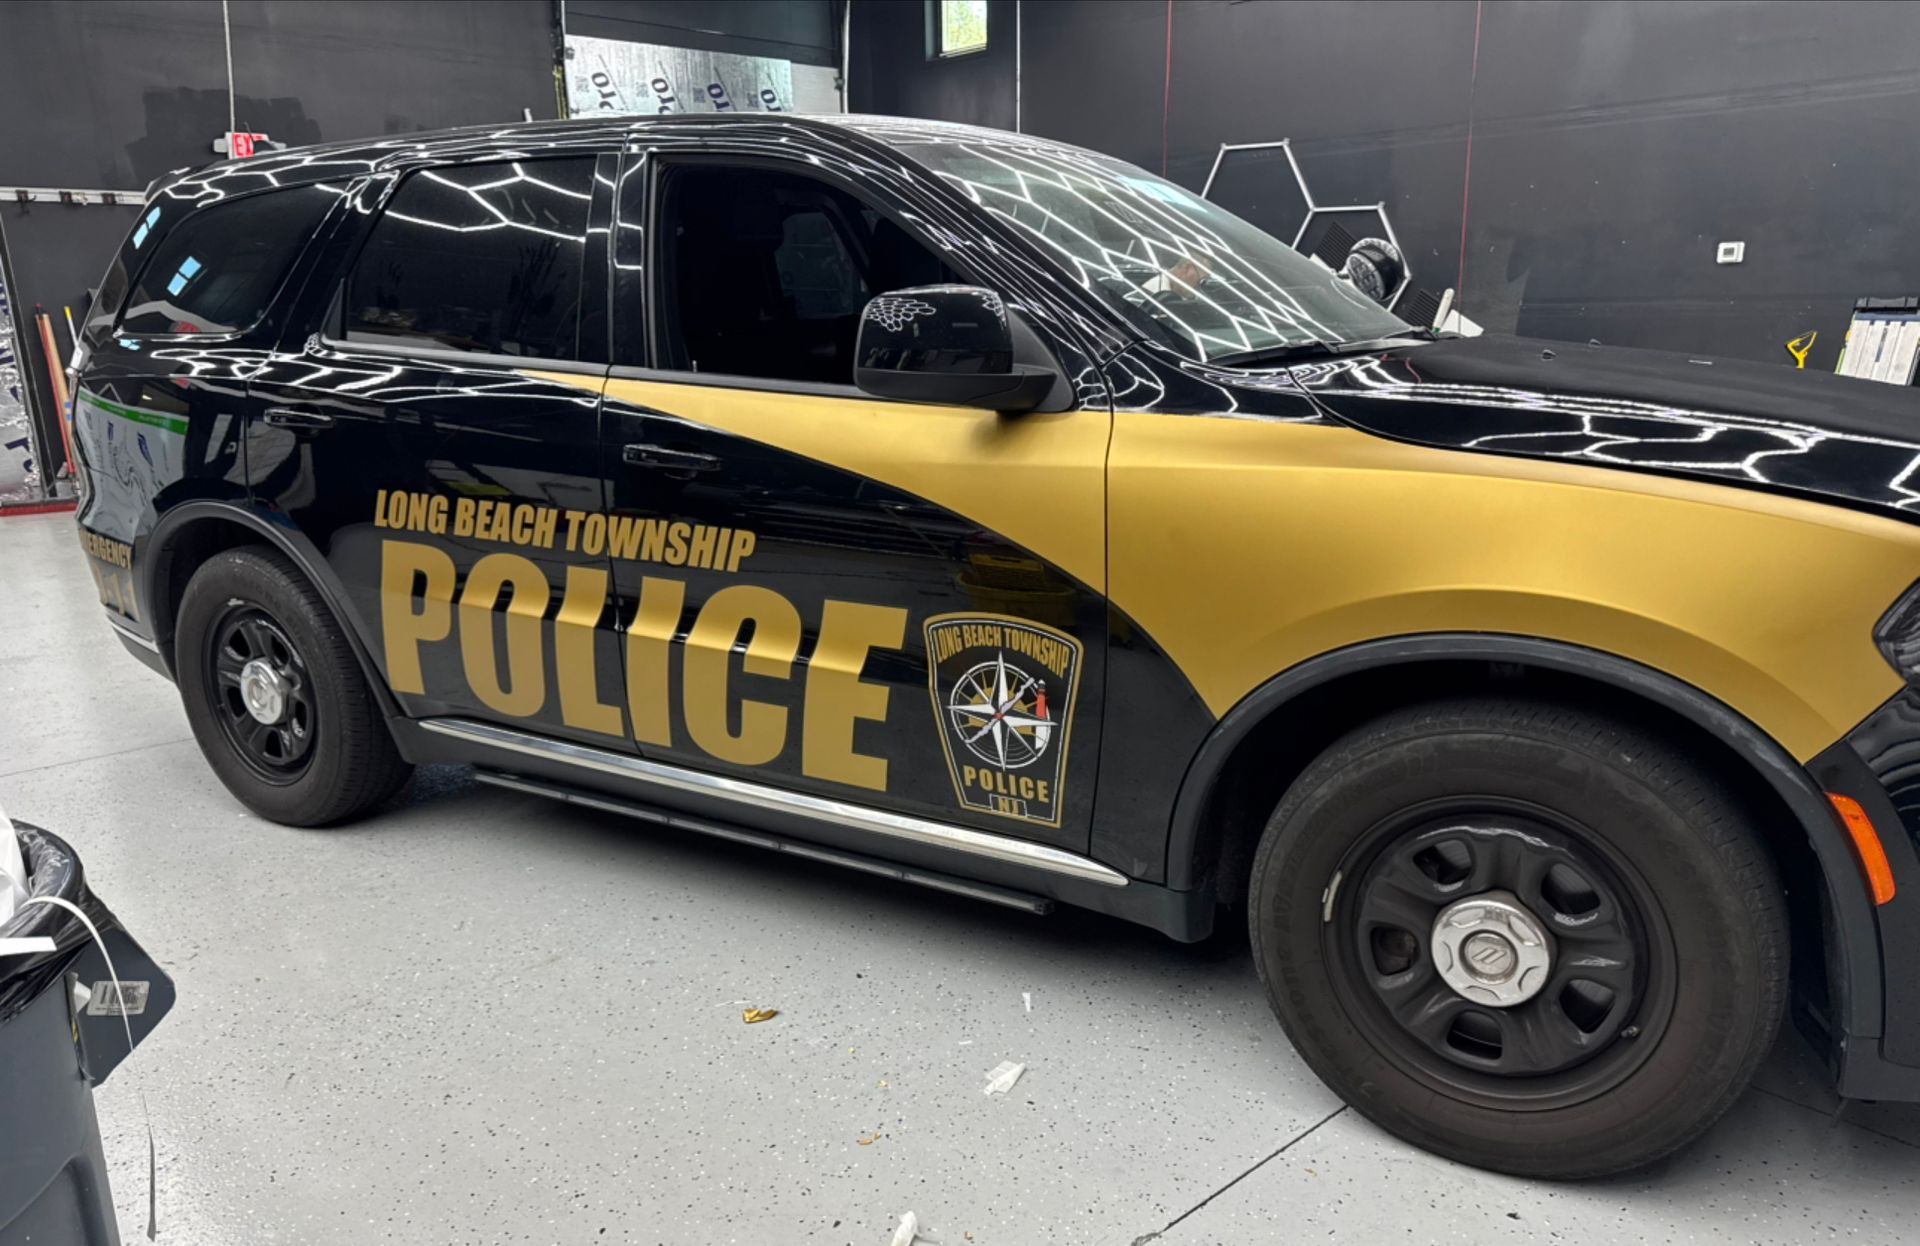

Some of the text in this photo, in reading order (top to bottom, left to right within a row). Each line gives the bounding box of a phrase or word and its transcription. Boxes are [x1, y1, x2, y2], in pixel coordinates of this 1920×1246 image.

[374, 489, 757, 573] LONG BEACH TOWNSHIP
[381, 539, 908, 792] POLICE
[934, 624, 1070, 679] LONG BEACH TOWNSHIP
[963, 765, 1049, 803] POLICE
[997, 798, 1020, 815] NJ
